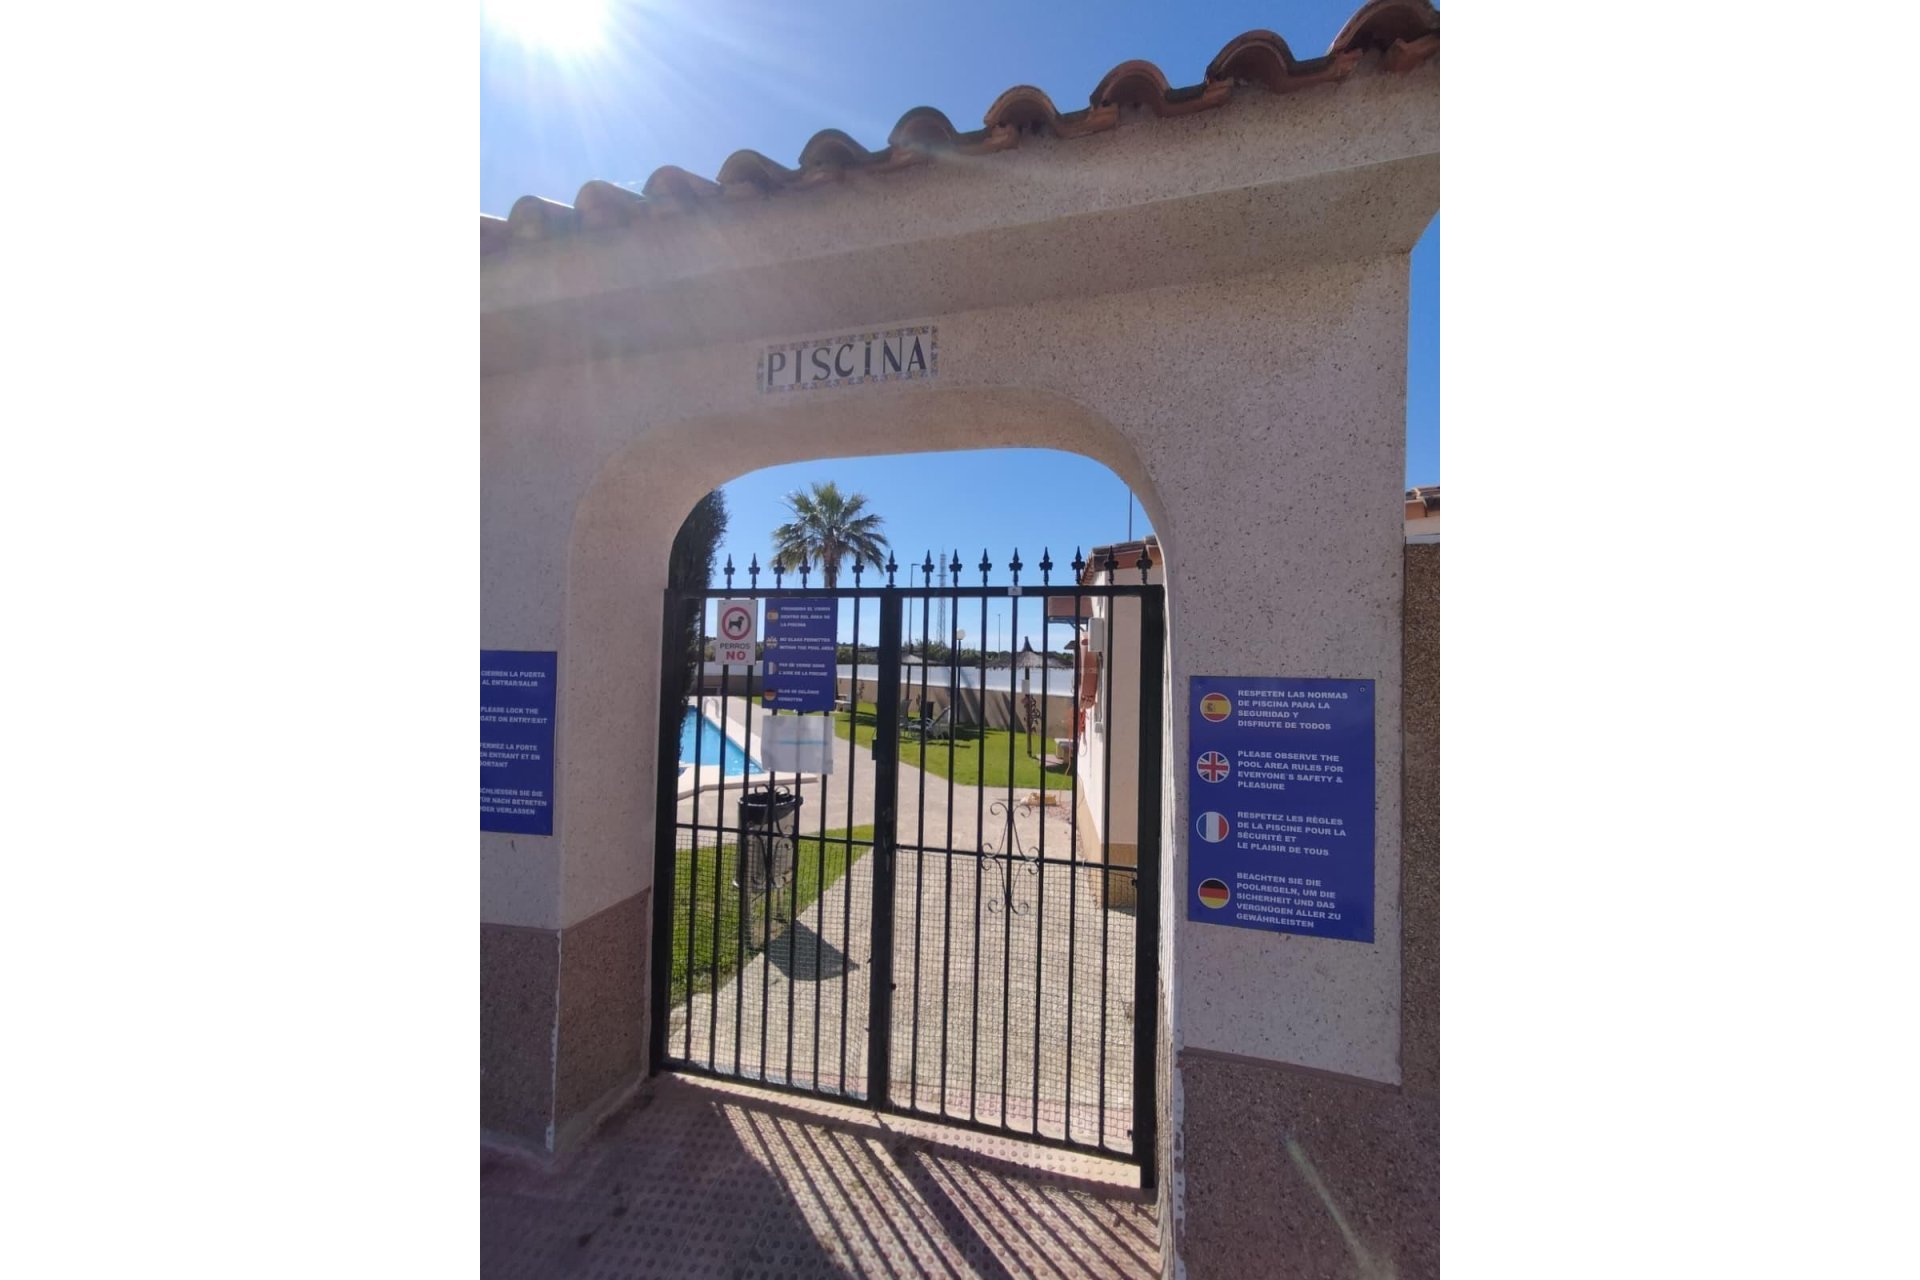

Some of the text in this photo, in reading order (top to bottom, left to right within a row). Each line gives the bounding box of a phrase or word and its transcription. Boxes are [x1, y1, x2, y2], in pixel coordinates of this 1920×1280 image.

[768, 335, 927, 386] PISCINA
[720, 642, 751, 650] PERROS
[726, 650, 746, 660] NO
[1238, 690, 1348, 699] RESPETEN LAS NORMAS
[1252, 700, 1289, 708] PISCINA
[1291, 701, 1315, 709] PARA
[1238, 710, 1290, 718] SEGURIDAD
[1238, 720, 1282, 729] DISFRUTE
[1299, 722, 1332, 730] TODOS
[1274, 752, 1318, 761] OBSERVE
[1320, 754, 1340, 762] THE
[1238, 761, 1344, 773] POOL AREA RULES FOR
[1297, 773, 1333, 783] SAFETY
[1238, 781, 1285, 790] PLEASURE
[496, 806, 535, 815] VERLASSEN
[1237, 811, 1284, 821] RESPETEZ
[1286, 814, 1303, 822] LES
[1265, 824, 1302, 833] PISCINE
[1305, 826, 1332, 835] POUR
[1334, 828, 1346, 836] LA
[1237, 831, 1282, 842] SÉCURITÉ
[1251, 843, 1286, 852] PLAISIR
[1289, 846, 1301, 854] DE
[1304, 847, 1329, 856] TOUS
[1237, 872, 1321, 887] BEACHTEN SIE DIE
[1236, 883, 1336, 898] POOLREGELN, UM DIE
[1236, 893, 1336, 909] SICHERHEIT UND DAS
[1236, 903, 1341, 920] VERGNÜGEN ALLER ZU
[1236, 913, 1314, 928] GEWÄHRLEISTEN
